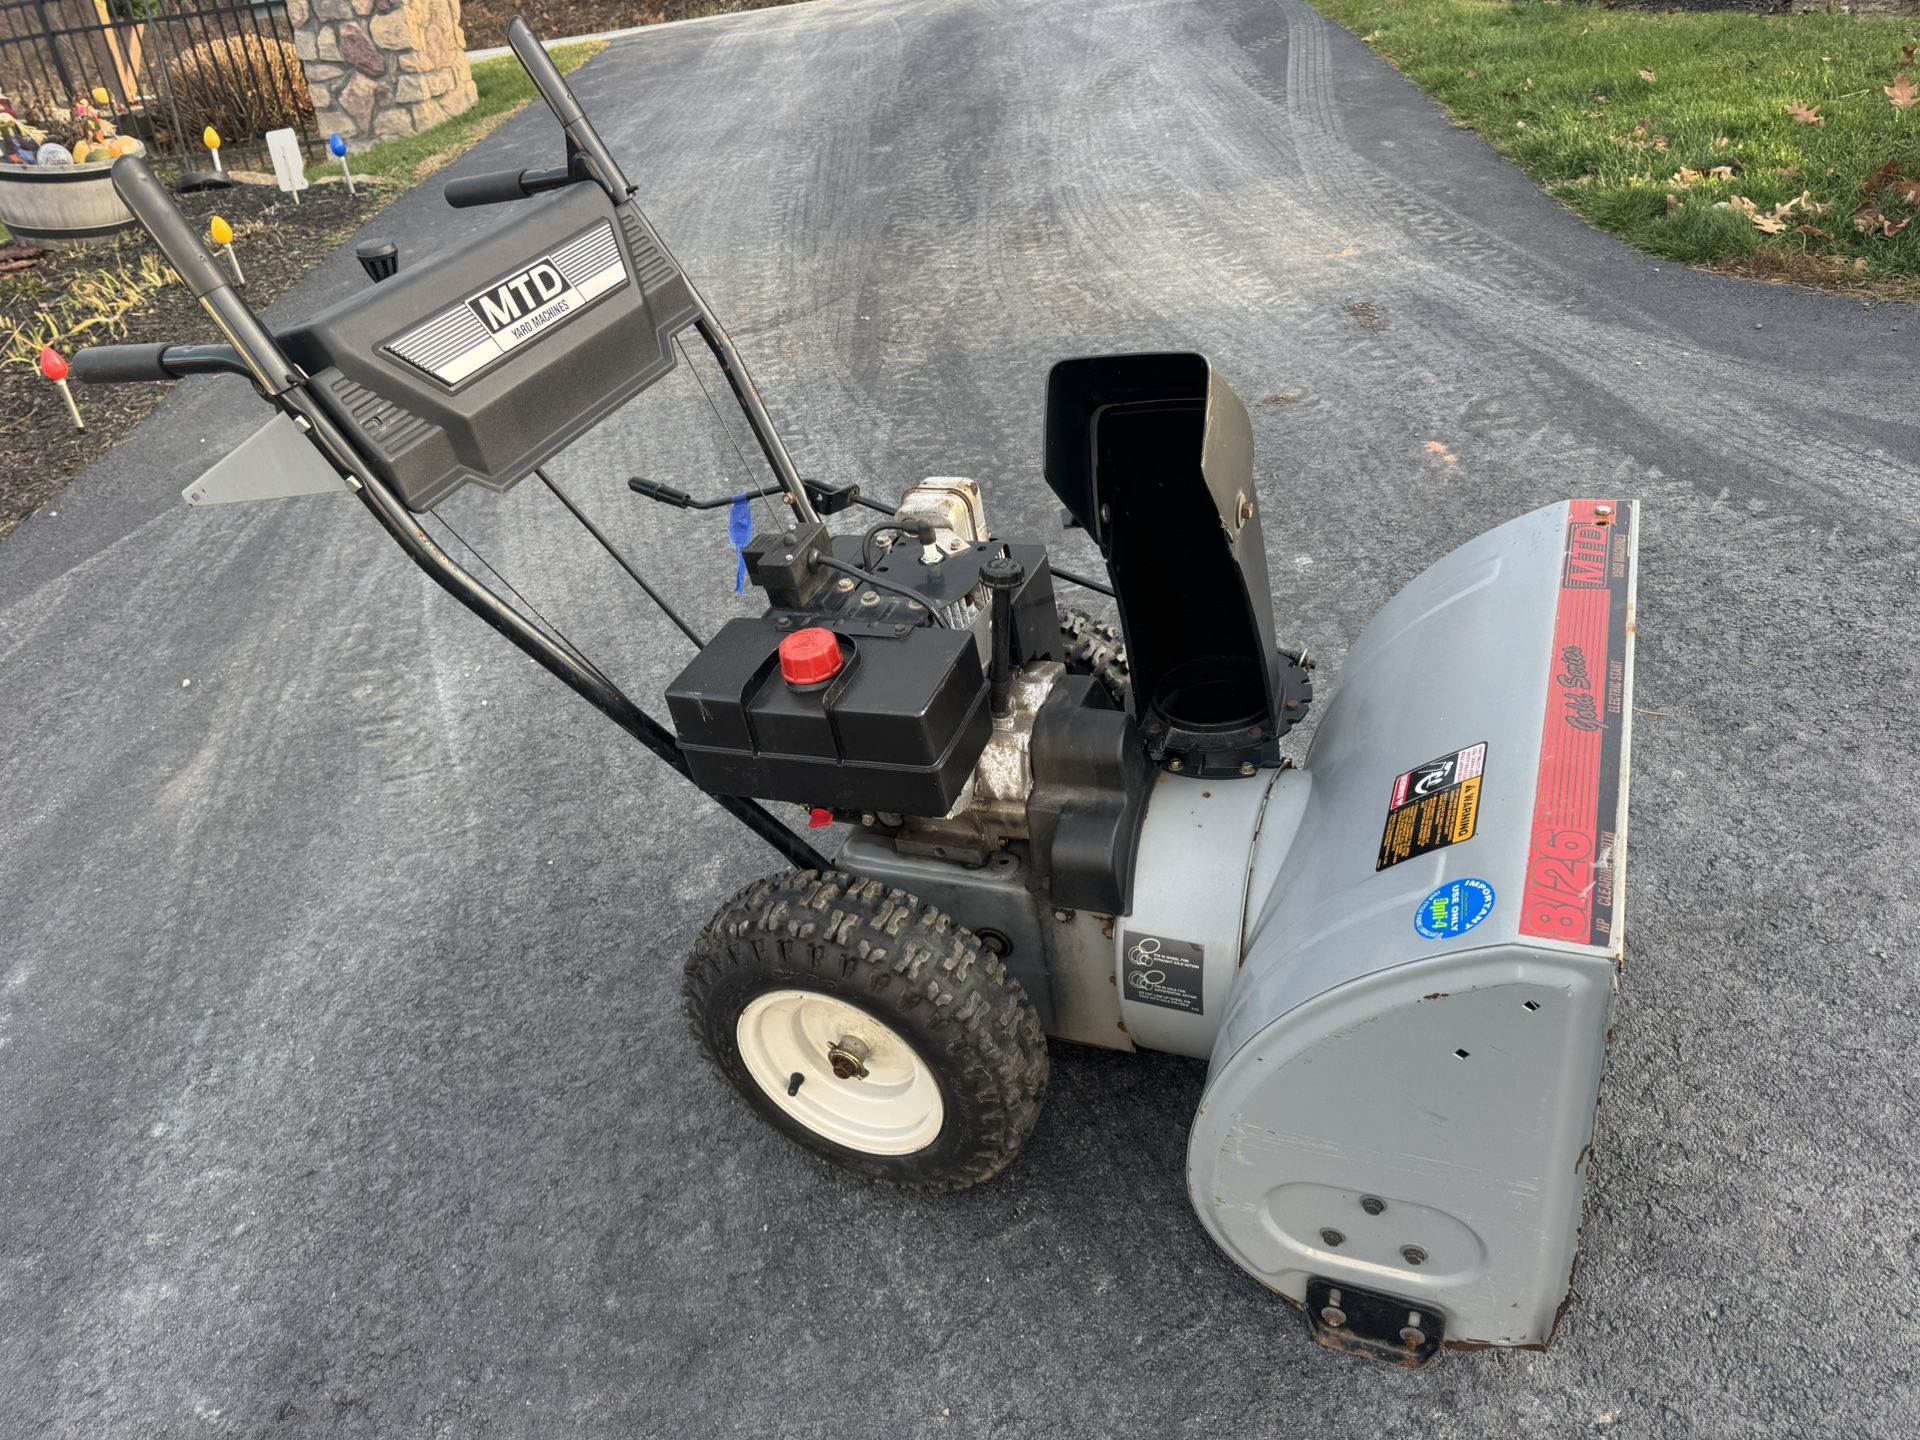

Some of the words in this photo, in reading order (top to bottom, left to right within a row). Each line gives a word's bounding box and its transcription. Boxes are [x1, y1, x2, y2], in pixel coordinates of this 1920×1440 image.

[478, 263, 563, 332] MTD
[510, 318, 534, 340] YARD
[531, 299, 570, 328] MACHINES
[1570, 526, 1608, 584] MTD
[1557, 646, 1591, 690] Series
[1610, 660, 1623, 681] START
[1608, 681, 1622, 714] ELECTRIC
[1458, 794, 1474, 837] WARNING
[1452, 884, 1460, 904] USE
[1464, 880, 1492, 930] IMPORTANT
[1451, 906, 1459, 931] ONLY
[1596, 918, 1610, 934] HP
